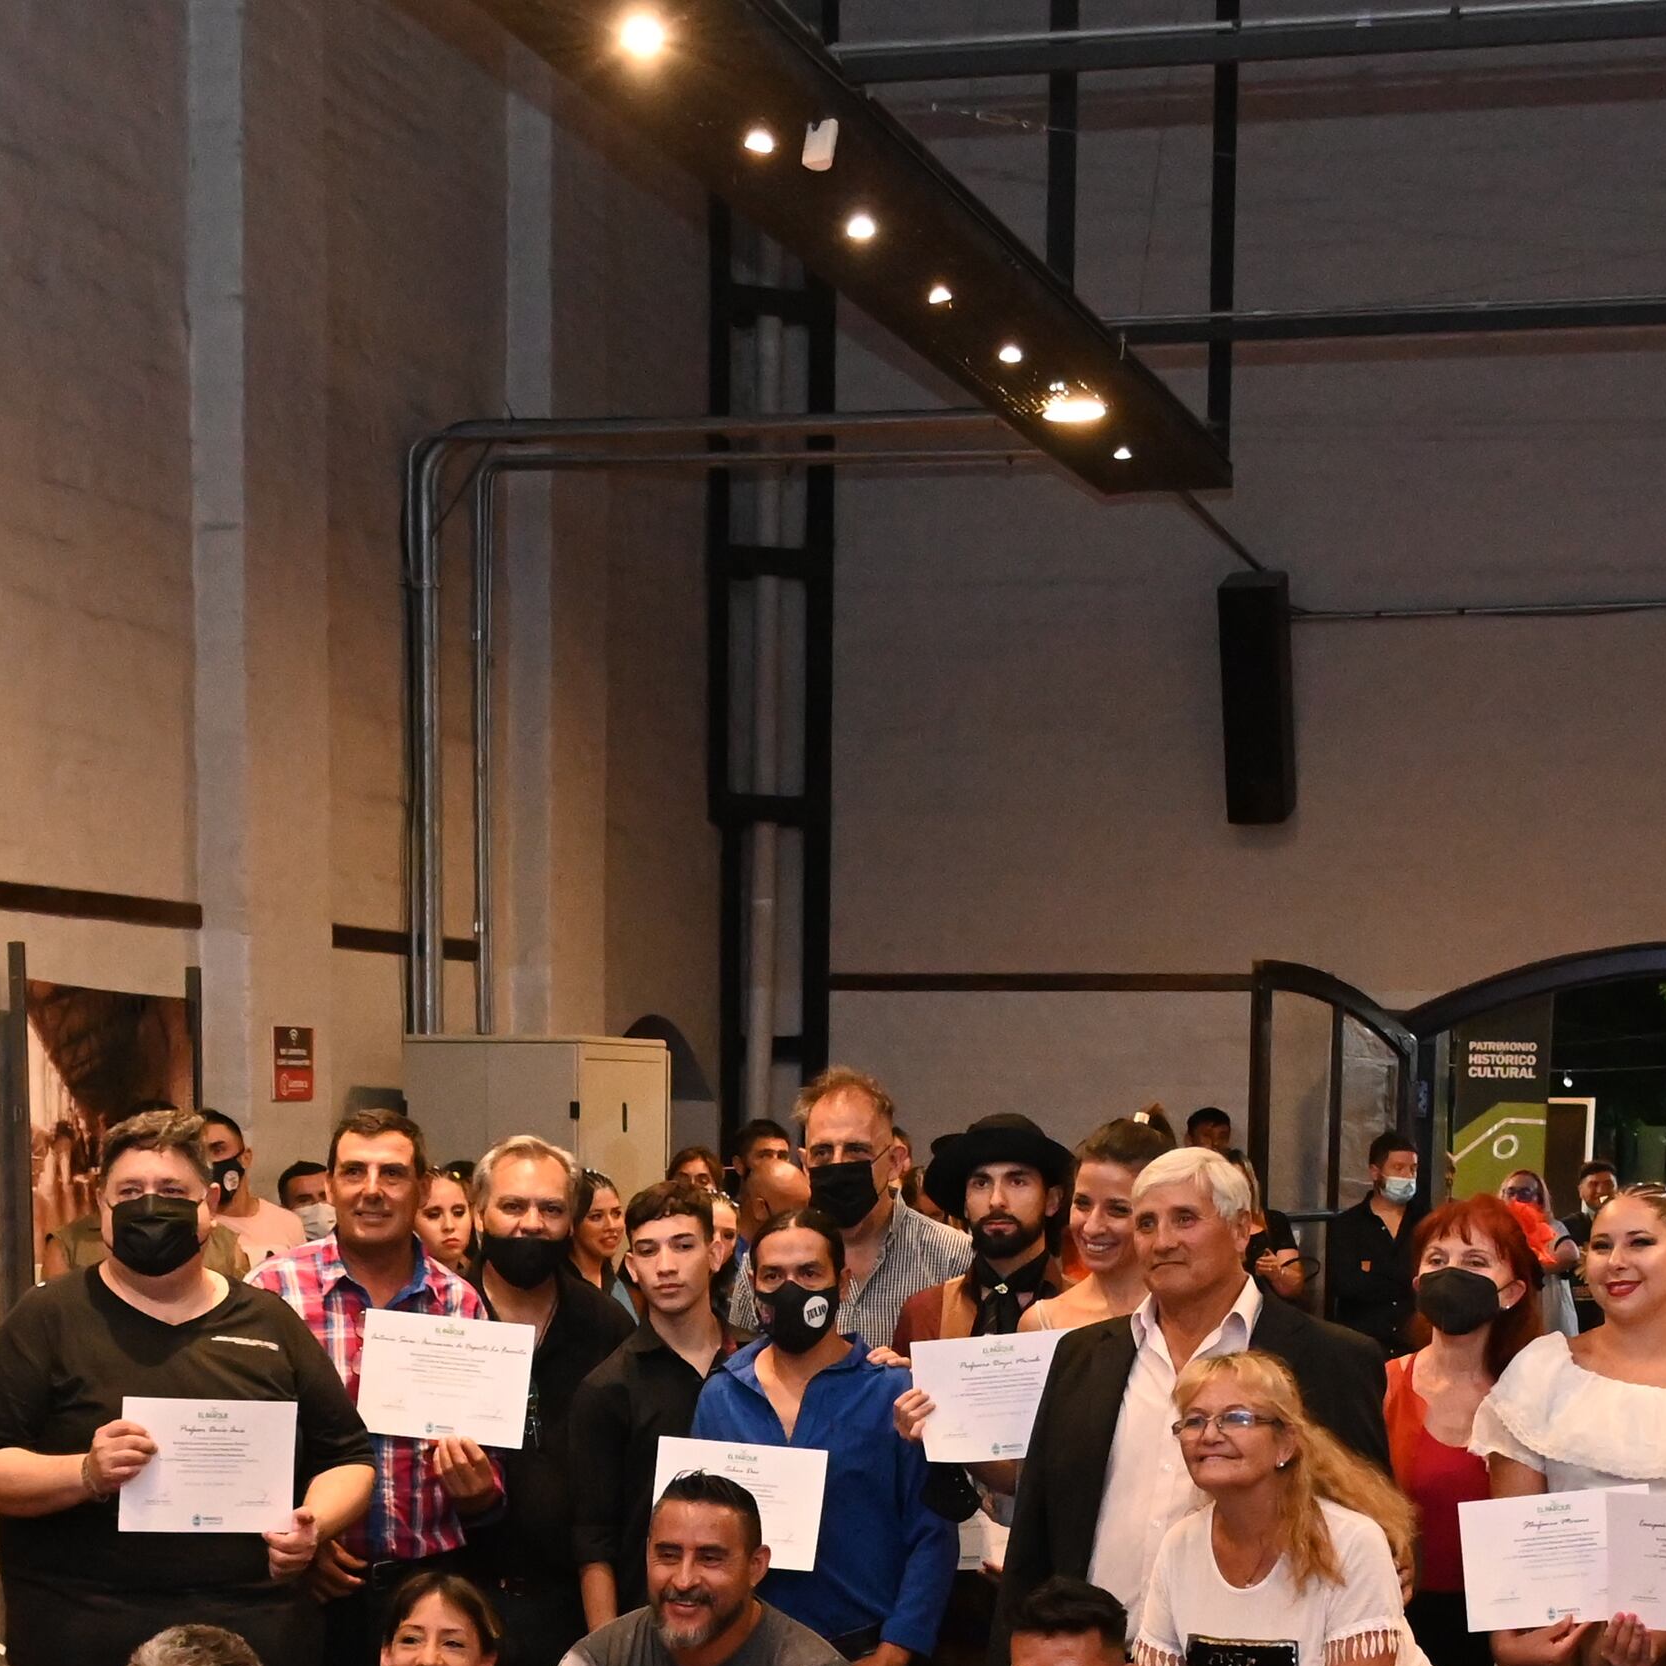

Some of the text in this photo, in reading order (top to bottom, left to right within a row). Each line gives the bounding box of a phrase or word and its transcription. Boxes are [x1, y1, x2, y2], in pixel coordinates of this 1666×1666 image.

[1468, 1041, 1538, 1052] PATRIMONIO
[1468, 1051, 1537, 1066] HISTÓRICO
[1468, 1066, 1537, 1079] CULTURAL
[806, 1303, 827, 1322] JULIO
